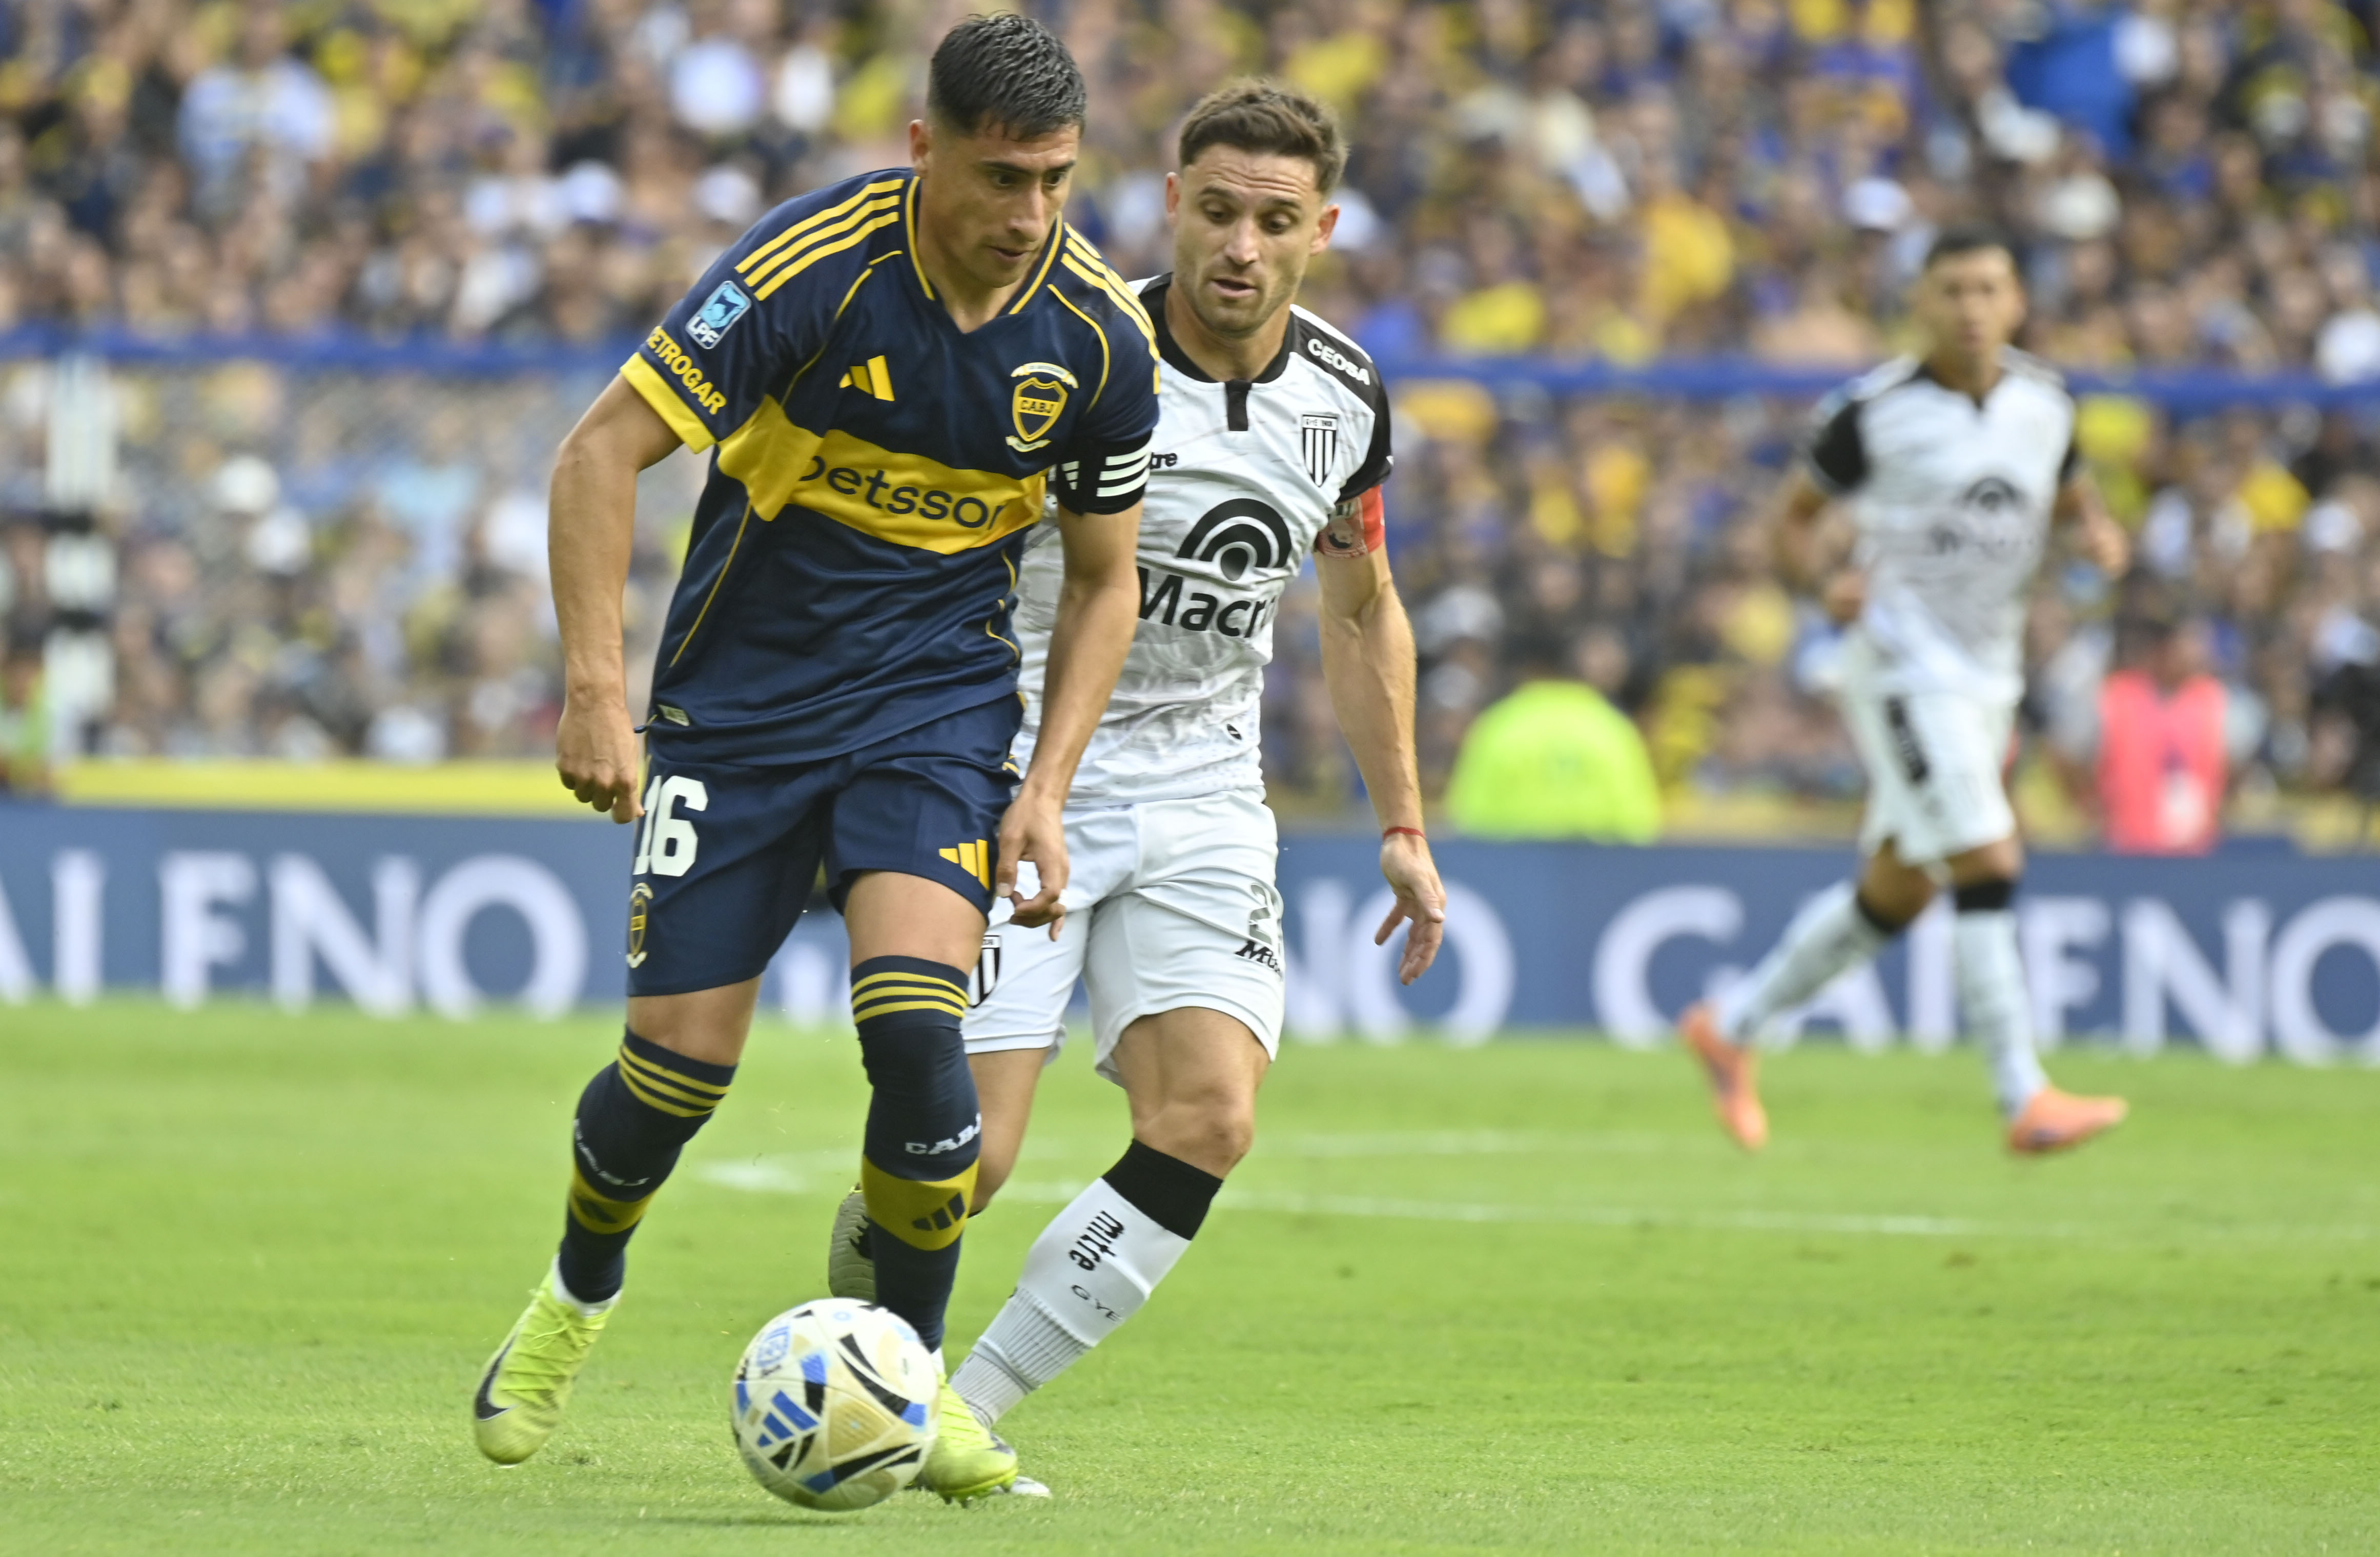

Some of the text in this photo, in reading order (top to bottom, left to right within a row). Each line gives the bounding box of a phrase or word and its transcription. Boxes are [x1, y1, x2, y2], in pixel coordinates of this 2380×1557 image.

[688, 316, 721, 343] LPF
[1308, 339, 1370, 386] CEOSA
[646, 326, 727, 415] ETROGAR
[1137, 566, 1275, 638] Macr
[633, 775, 709, 877] 16
[1068, 1210, 1125, 1271] mitre
